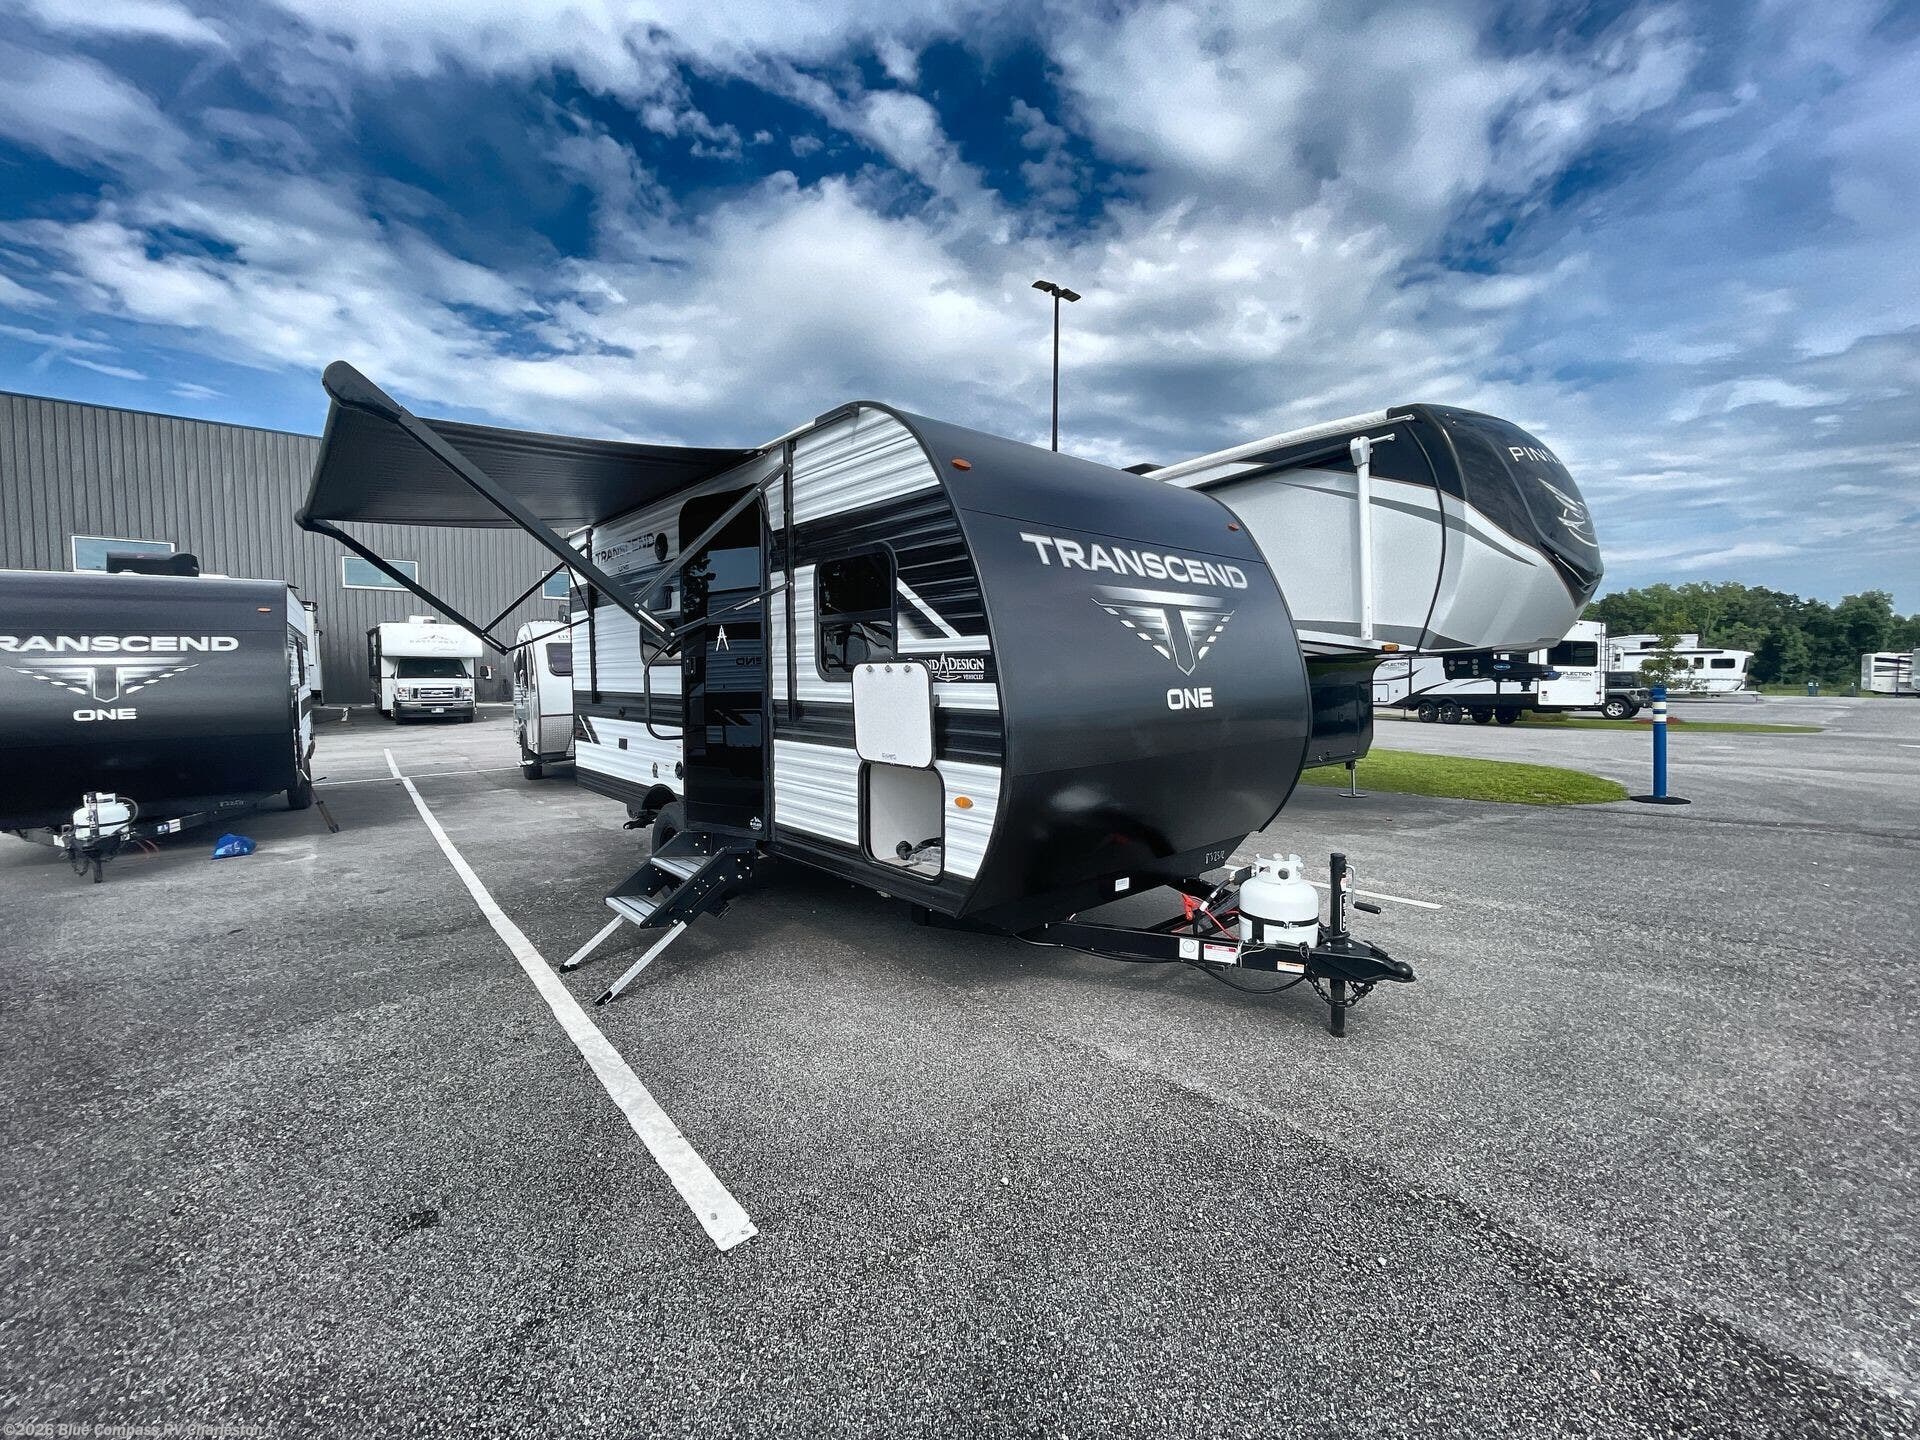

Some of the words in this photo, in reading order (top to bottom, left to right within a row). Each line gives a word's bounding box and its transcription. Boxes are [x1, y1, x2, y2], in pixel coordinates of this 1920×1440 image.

[1019, 531, 1249, 589] TRANSCEND
[0, 635, 239, 652] RANSCEND
[947, 657, 985, 671] DESIGN
[1166, 686, 1214, 711] ONE
[73, 707, 137, 723] ONE
